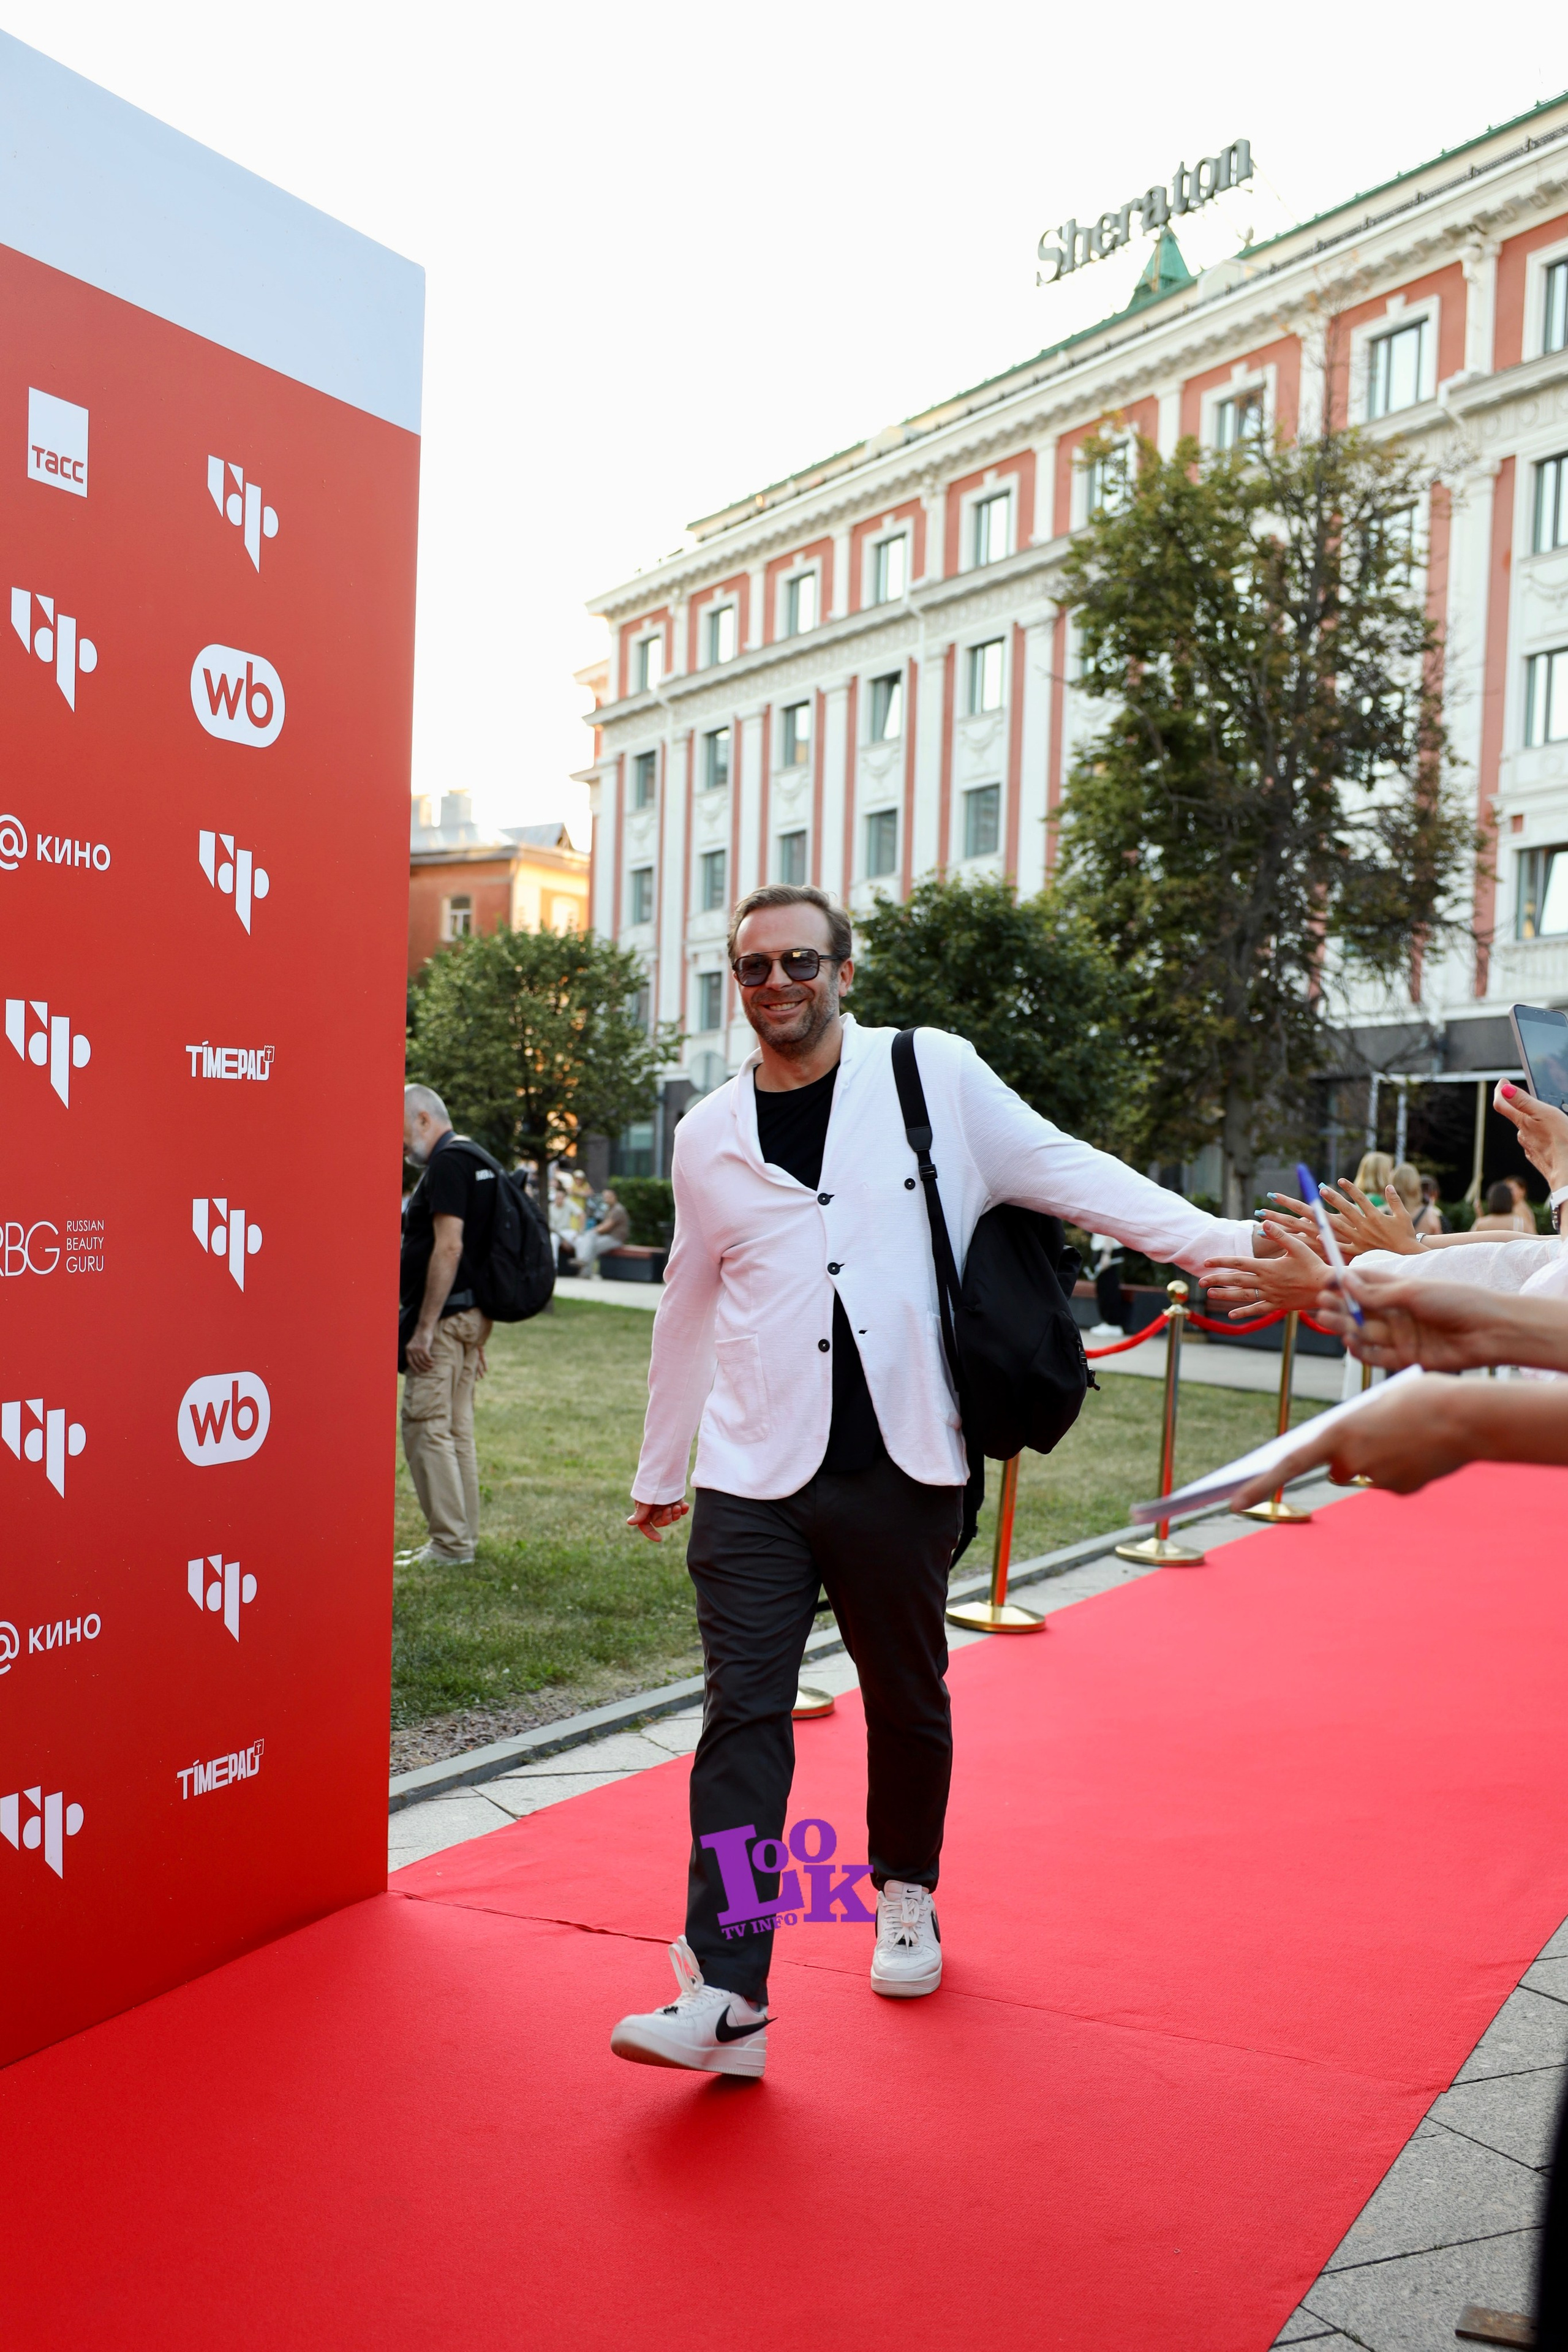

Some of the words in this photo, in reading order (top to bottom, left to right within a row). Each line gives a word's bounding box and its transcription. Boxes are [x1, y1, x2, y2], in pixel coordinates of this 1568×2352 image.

[1036, 138, 1253, 287] Sheraton
[203, 662, 273, 729] wb
[37, 834, 111, 871] КИНО
[66, 1219, 104, 1232] RUSSIAN
[66, 1237, 104, 1251] BEAUTY
[66, 1255, 104, 1273] GURU
[190, 1381, 259, 1447] wb
[29, 1613, 101, 1654] КИНО
